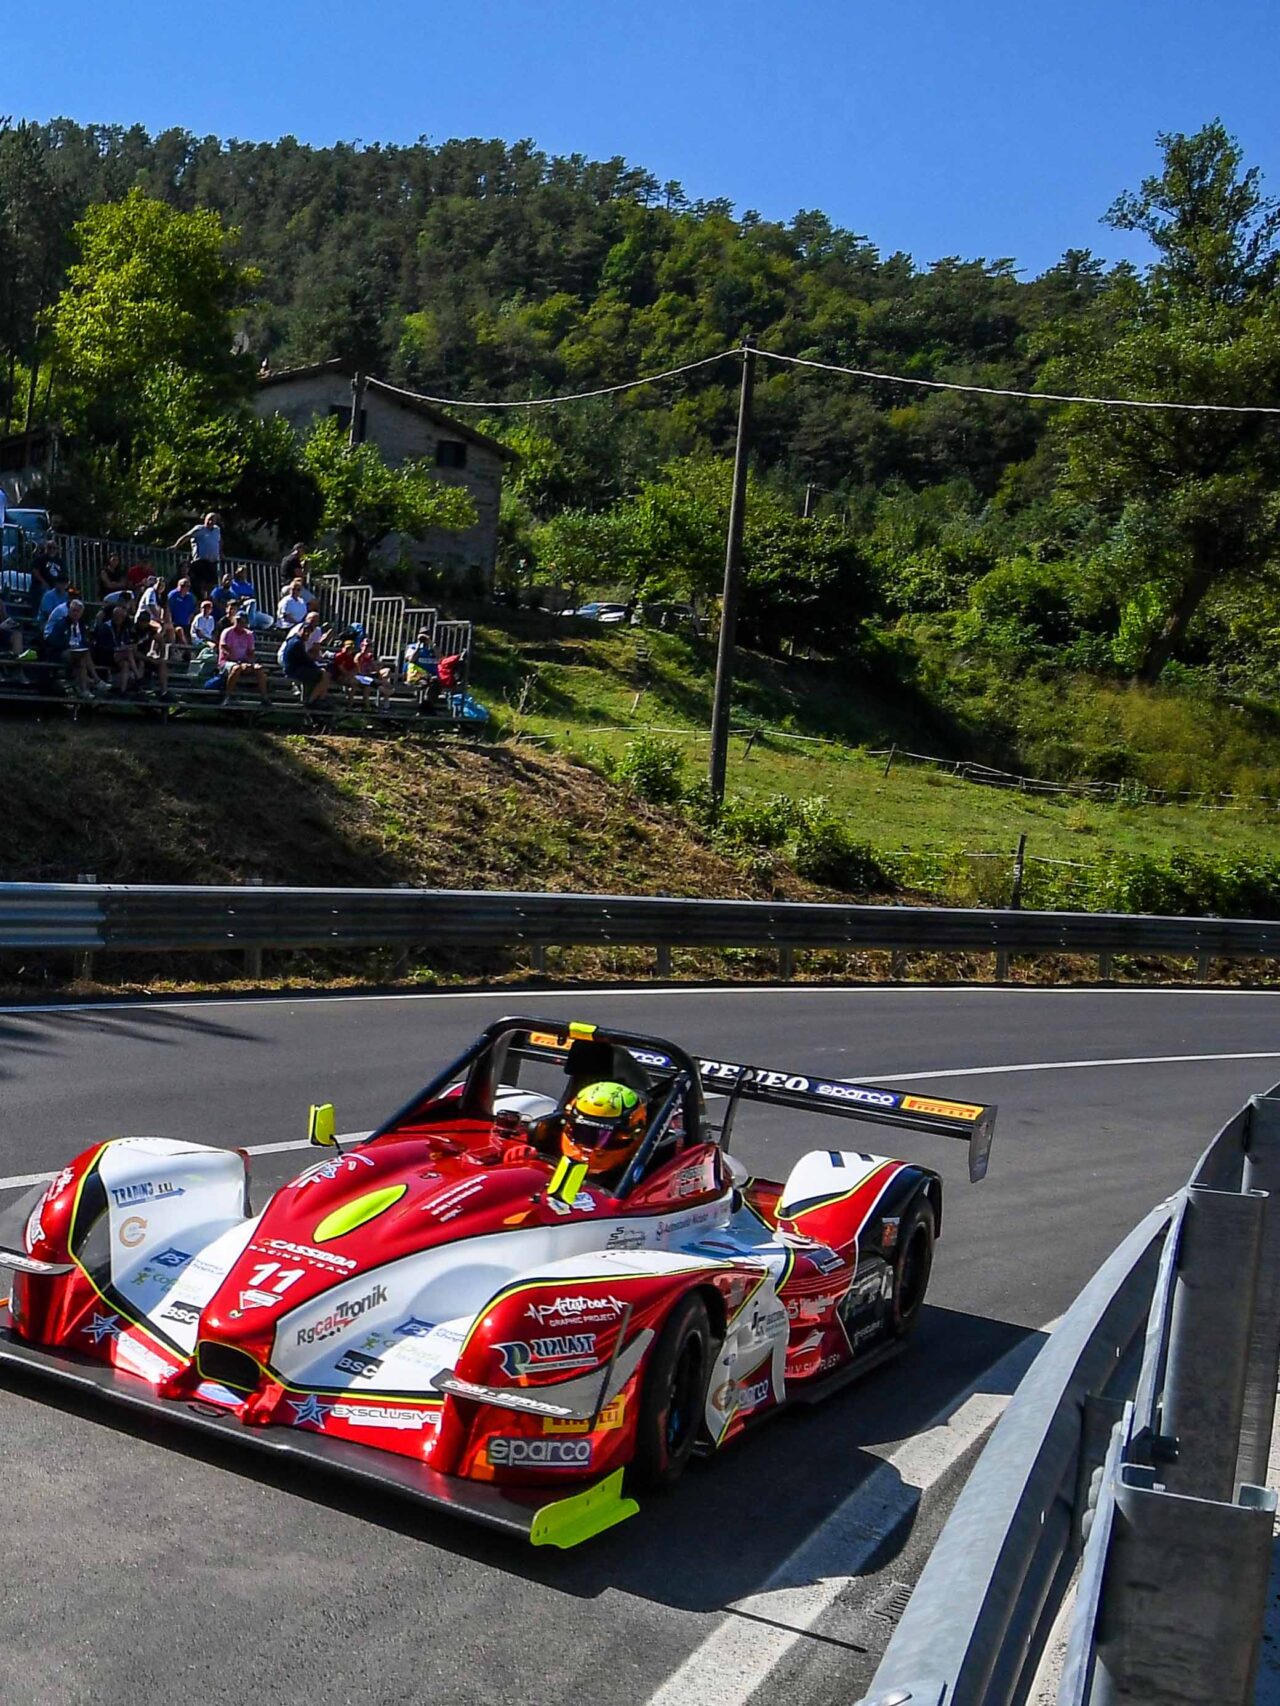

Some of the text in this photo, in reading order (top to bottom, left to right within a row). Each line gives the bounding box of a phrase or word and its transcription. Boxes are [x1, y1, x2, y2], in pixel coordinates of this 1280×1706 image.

[815, 1084, 895, 1106] sparco
[248, 1244, 349, 1276] RACING TEAM
[247, 1262, 306, 1294] 11
[165, 1306, 200, 1324] BSC
[549, 1312, 617, 1328] GRAPHIC PROJECT
[338, 1356, 379, 1378] BSC
[332, 1406, 441, 1423] EXSCLUSIVE
[489, 1438, 590, 1466] sparco
